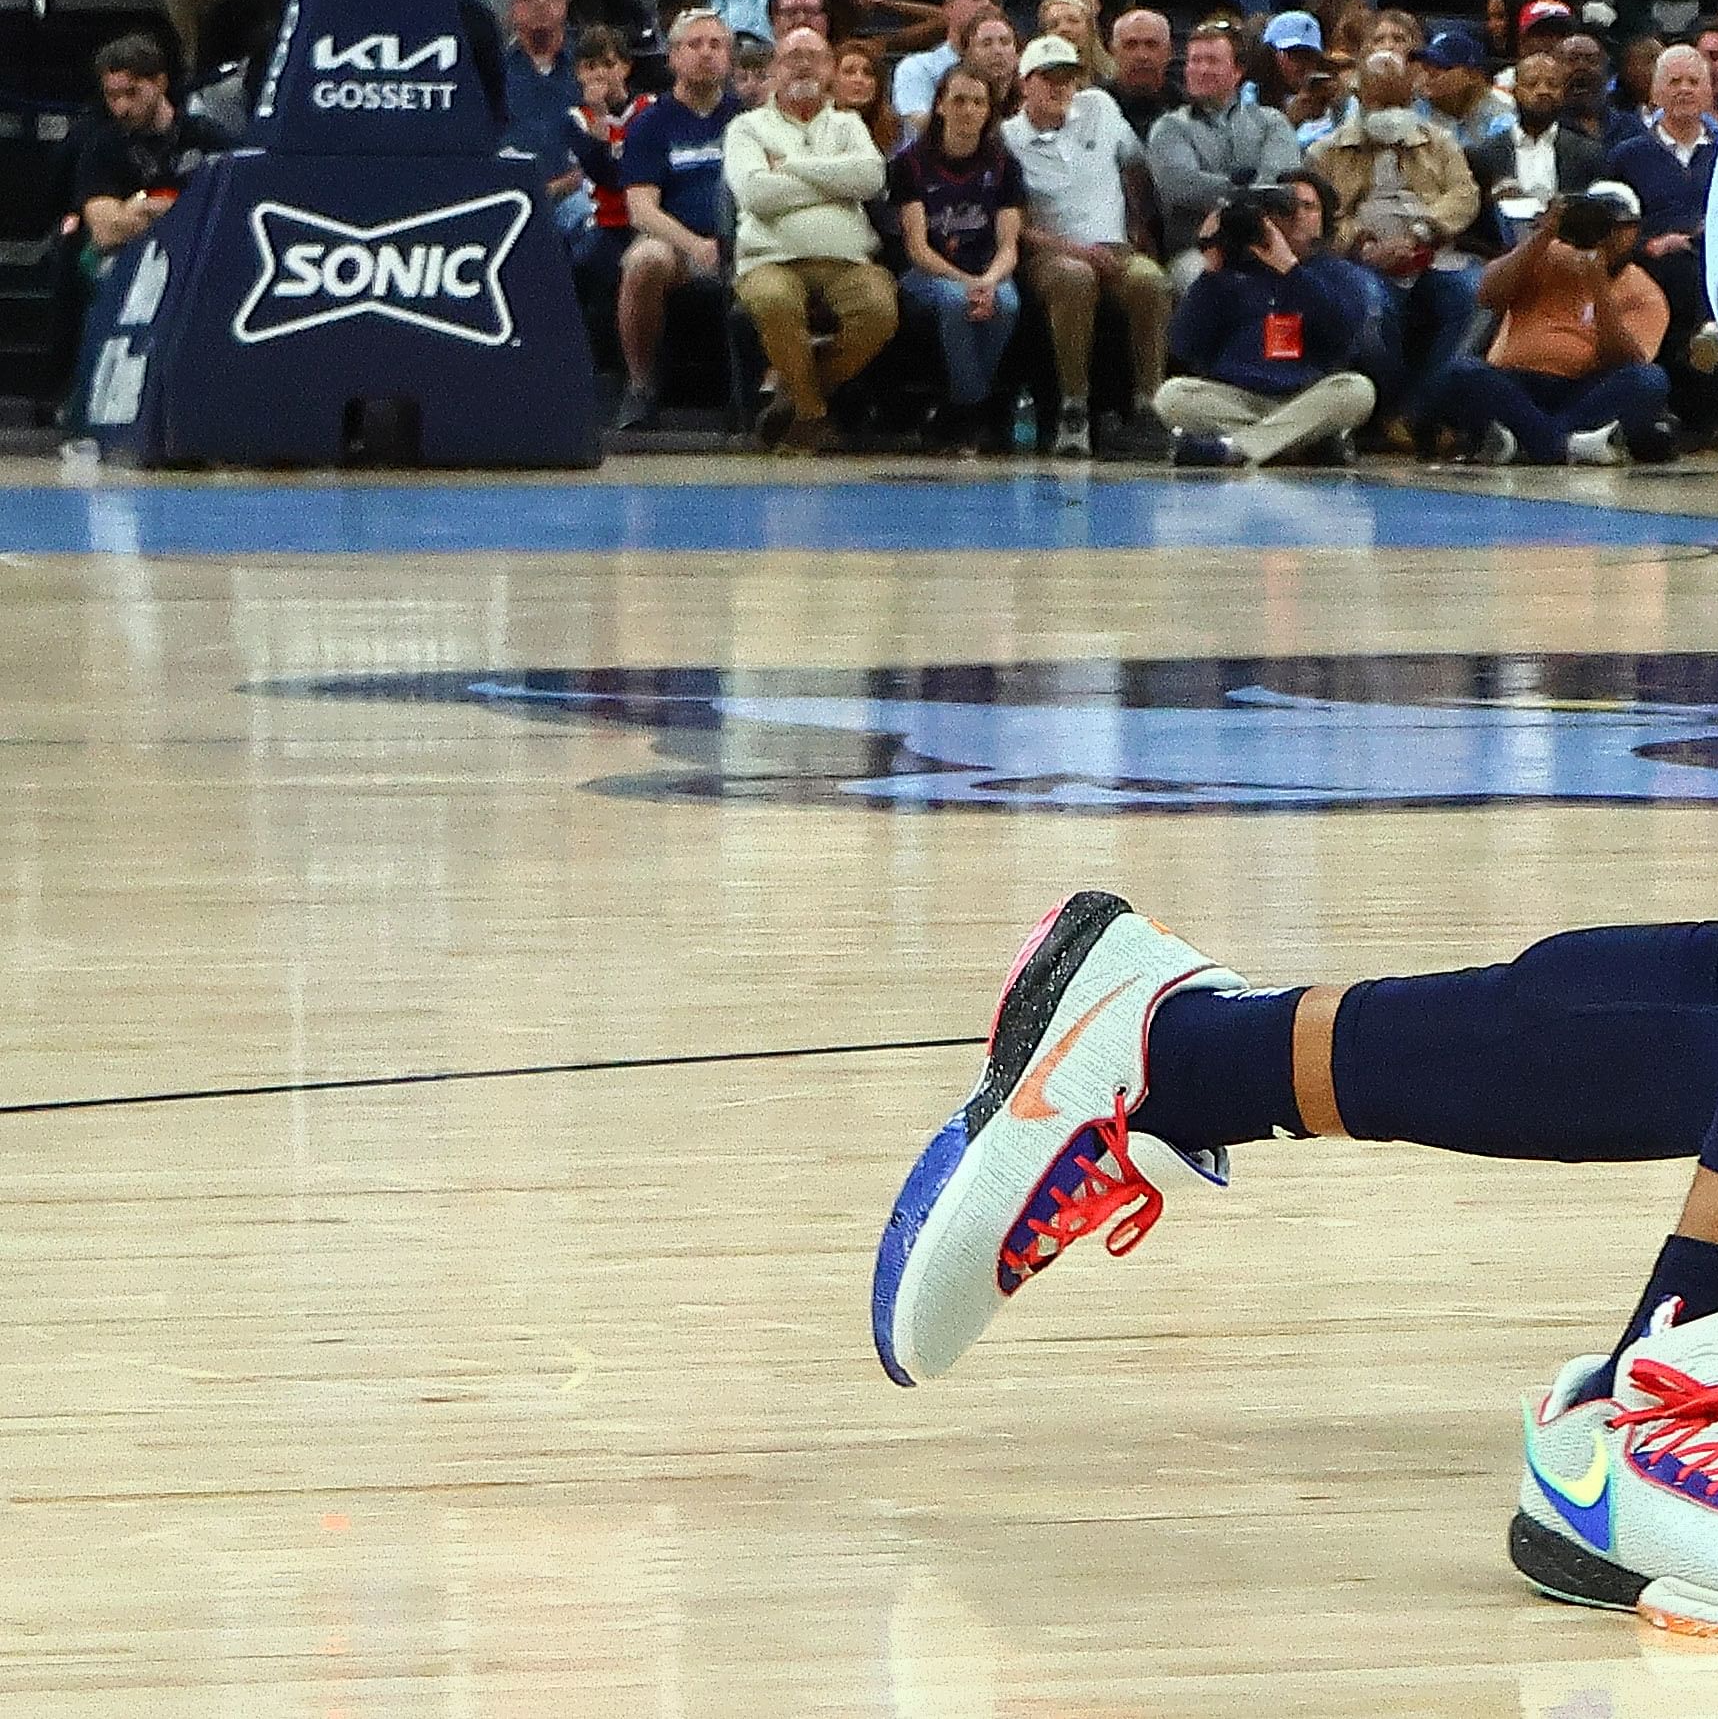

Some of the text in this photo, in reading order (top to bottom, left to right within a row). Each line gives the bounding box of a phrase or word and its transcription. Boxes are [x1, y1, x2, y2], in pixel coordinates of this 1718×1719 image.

[313, 35, 458, 70] KIA
[313, 81, 457, 110] GOSSETT
[274, 244, 487, 298] SONIC
